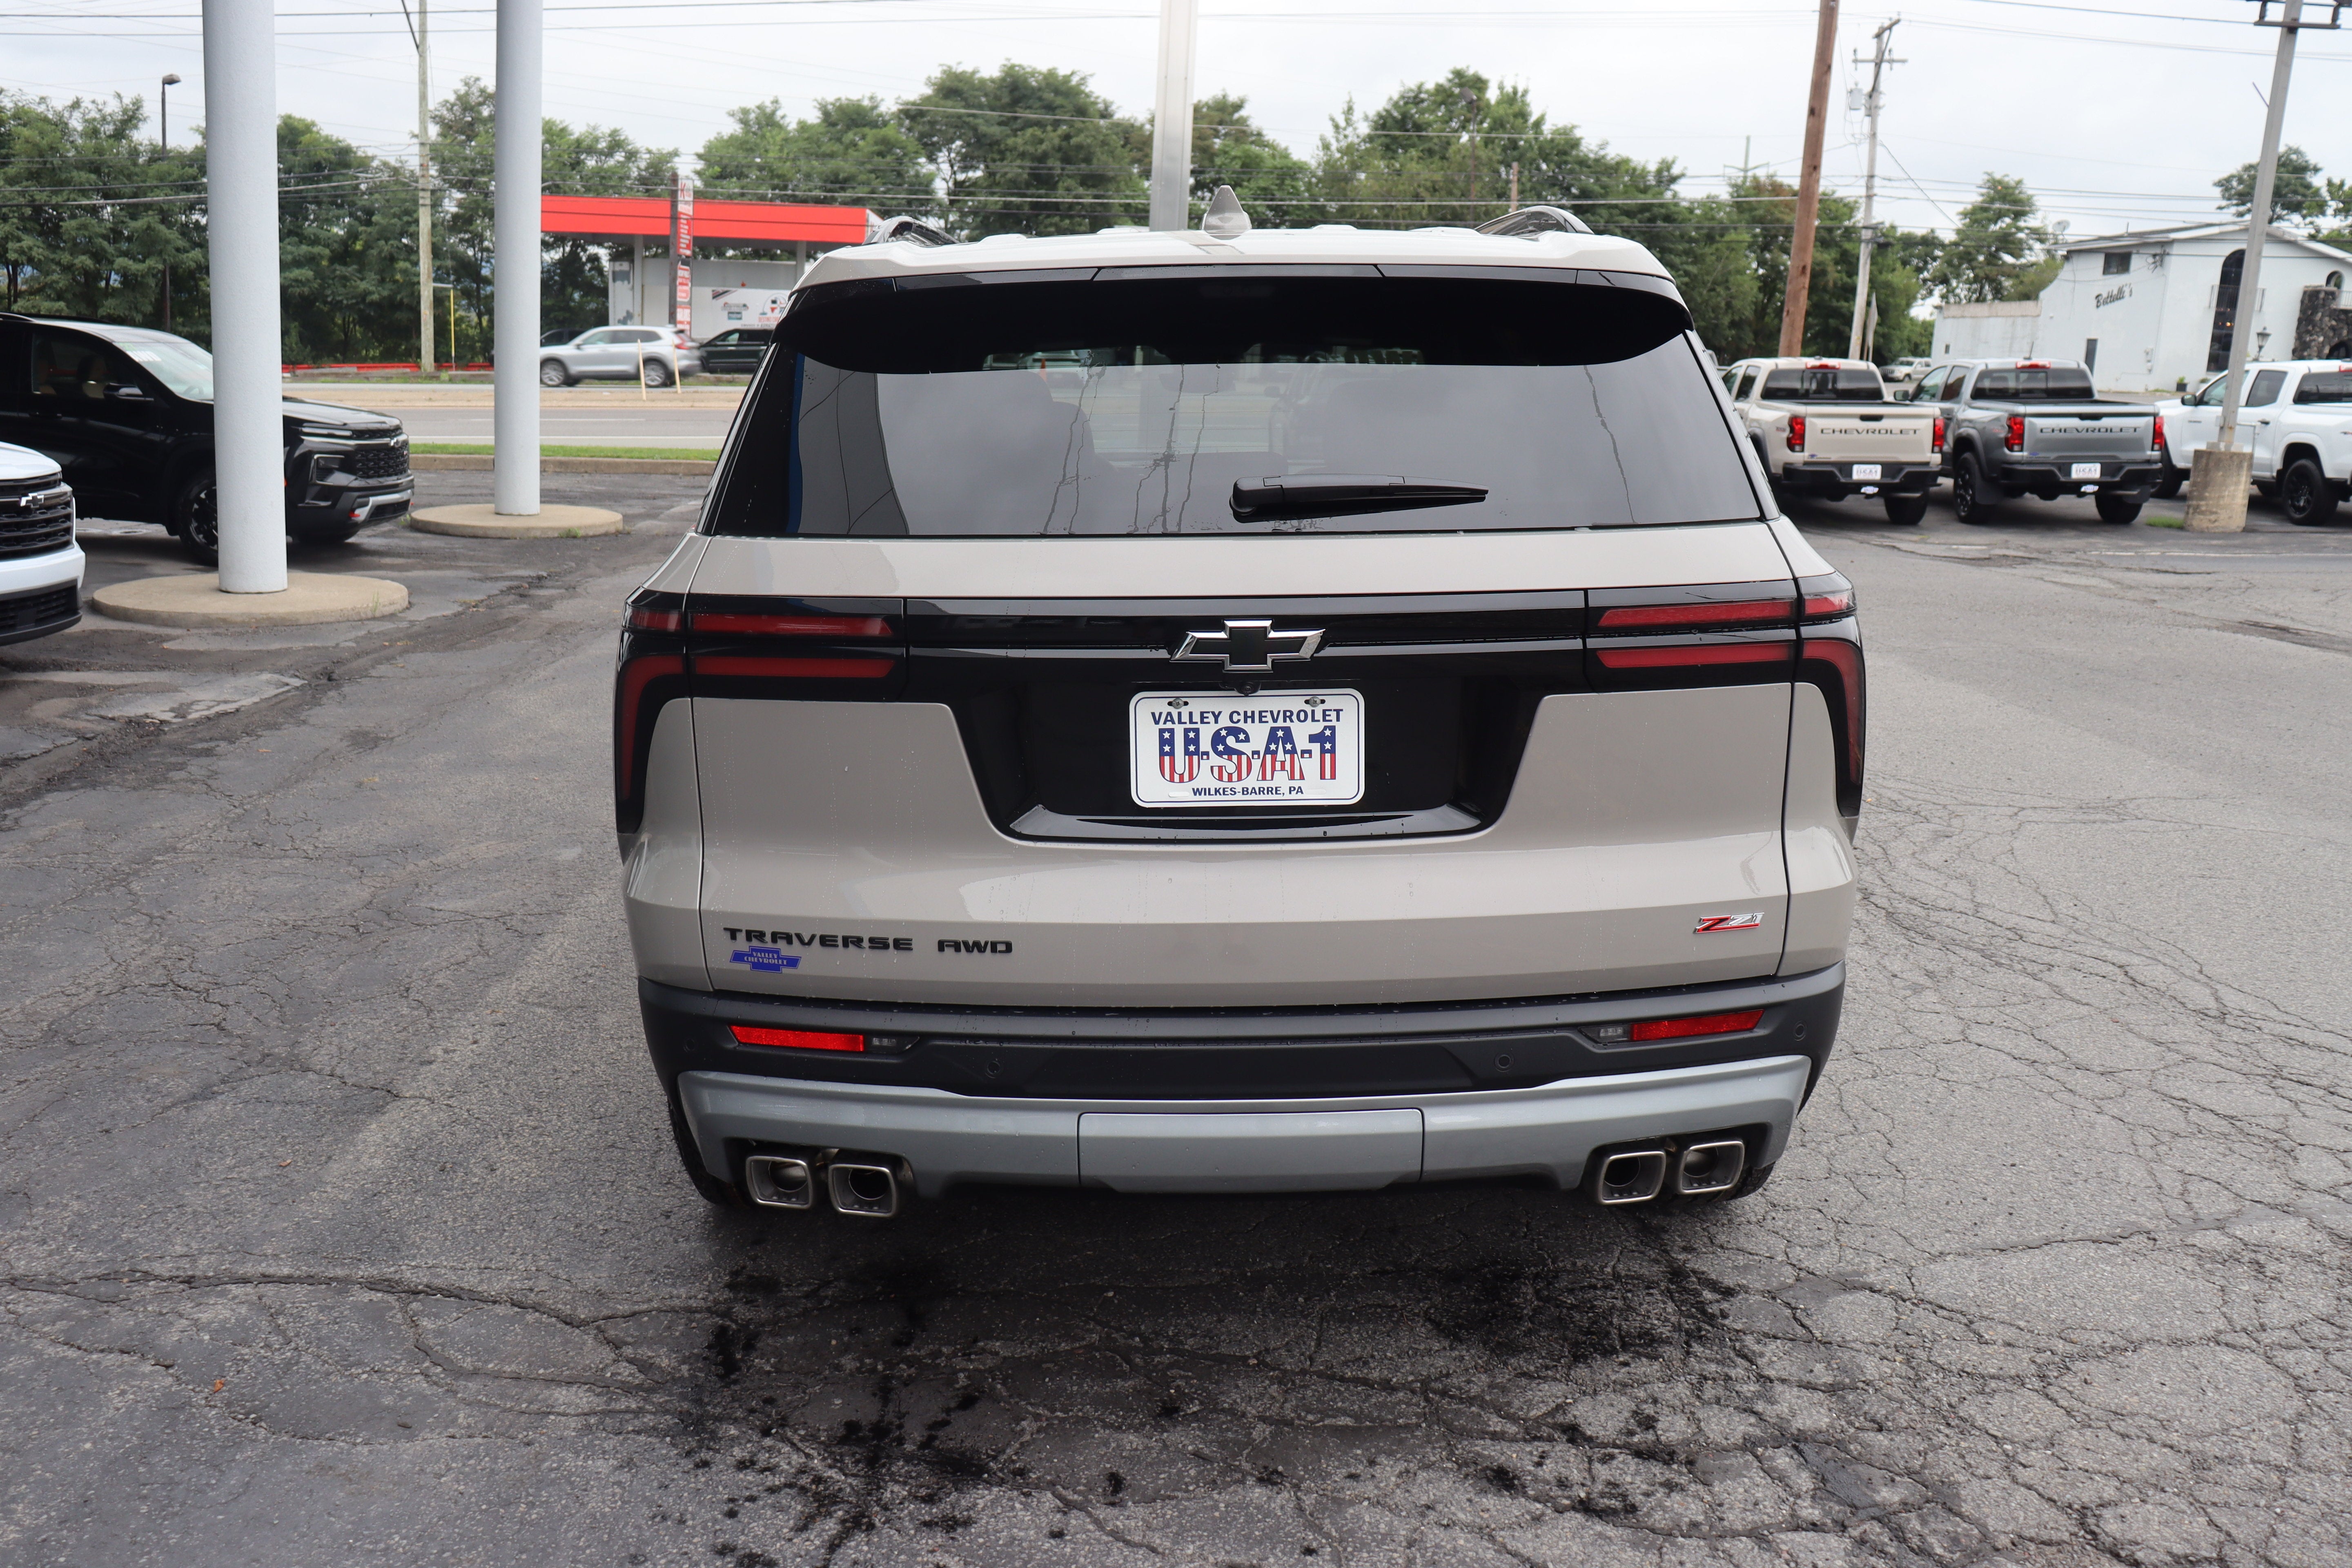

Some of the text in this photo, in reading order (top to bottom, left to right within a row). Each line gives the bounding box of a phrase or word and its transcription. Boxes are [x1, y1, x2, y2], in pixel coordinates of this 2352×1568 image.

[1151, 708, 1343, 725] VALLEY CHEVROLET
[1192, 786, 1304, 797] WILKES-BARRE, PA
[1693, 912, 1765, 934] Z71
[723, 927, 1013, 954] TRAVERSE AWD
[744, 956, 787, 965] CHEVROLET
